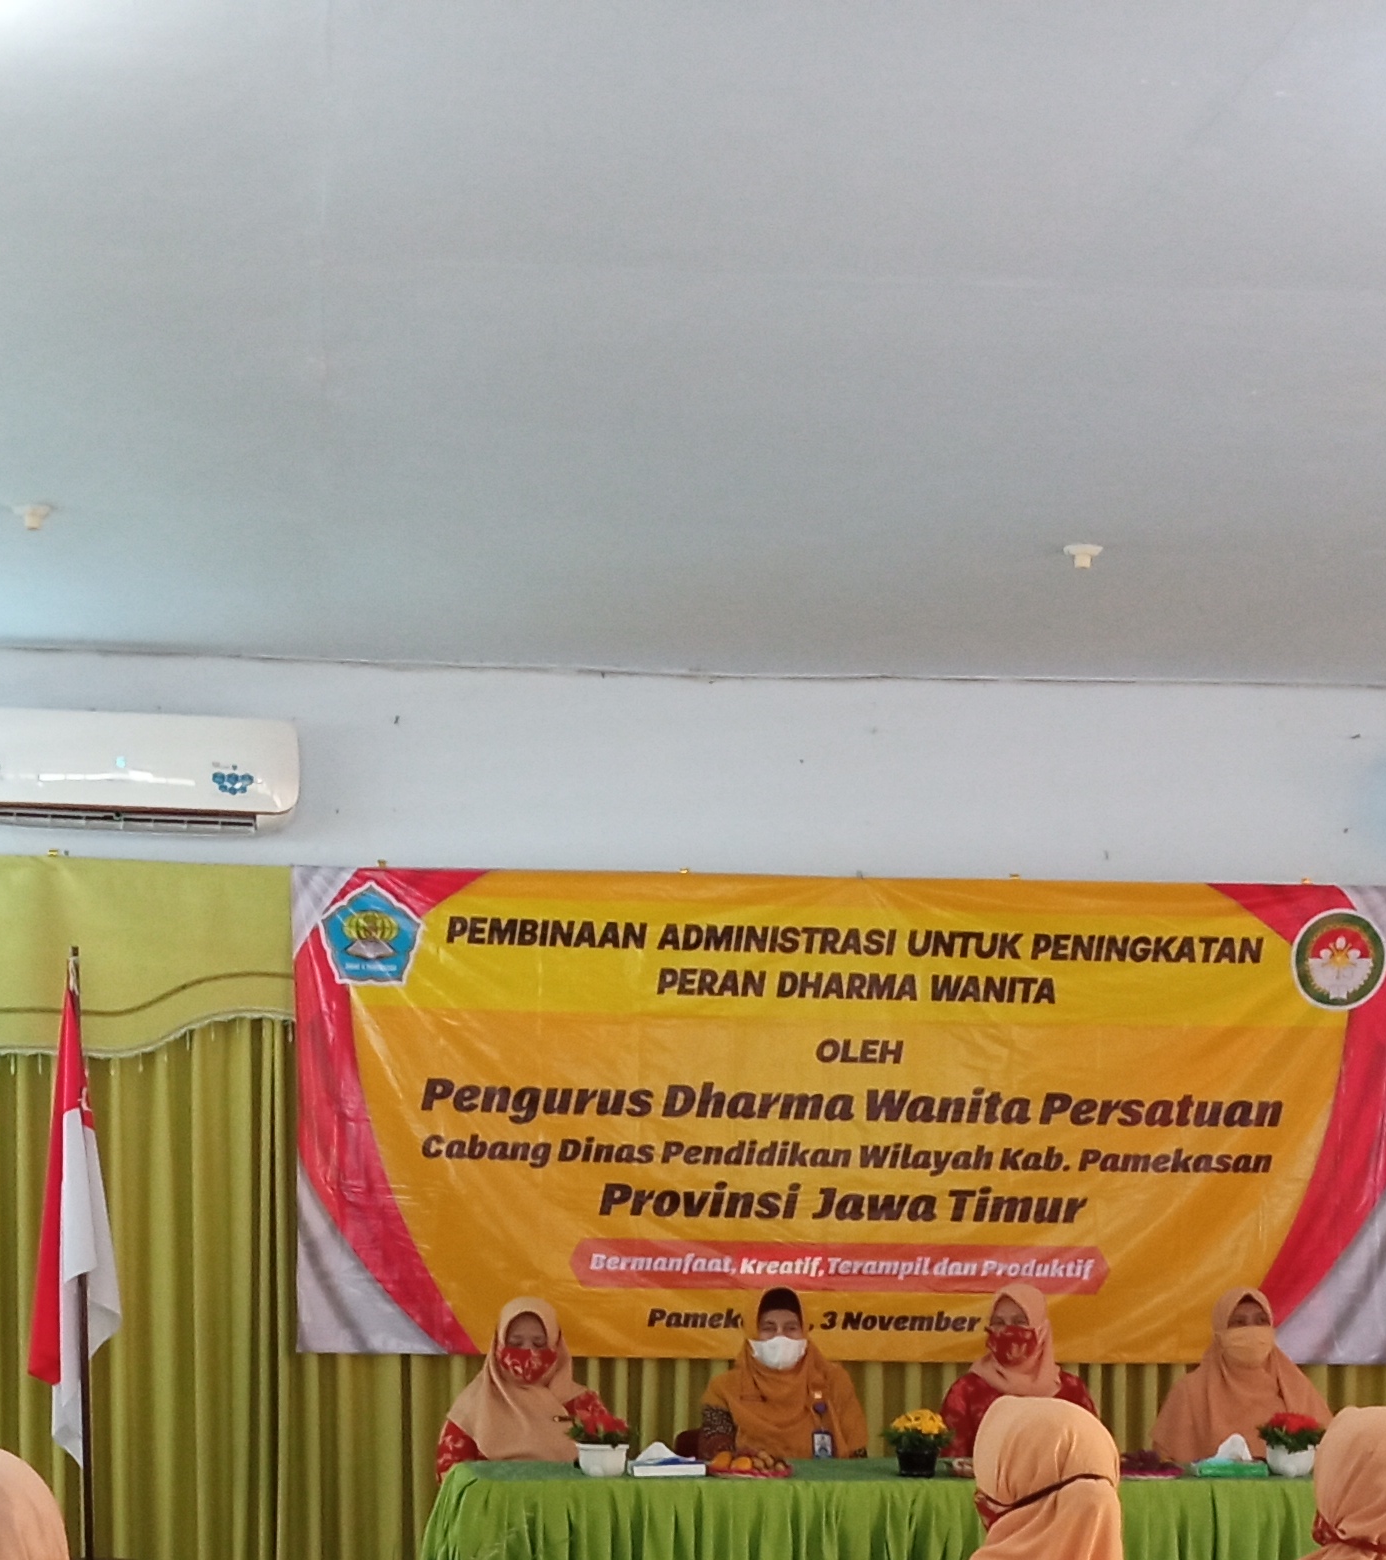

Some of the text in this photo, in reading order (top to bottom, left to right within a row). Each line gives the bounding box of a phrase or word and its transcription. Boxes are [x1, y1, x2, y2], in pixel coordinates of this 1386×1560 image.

[447, 917, 1263, 963] PEMBINAAN ADMINISTRASI UNTUK PENINGKATAN
[657, 968, 1055, 1004] PERAN DHARMA WANITA
[816, 1039, 903, 1064] OLEH
[422, 1079, 1282, 1127] Pengurus Dharma Wanita Persatuan
[422, 1135, 1272, 1176] Cabang Dinas Pendidikan Wilayah Kab. Pamekasan
[599, 1182, 1087, 1224] Provinsi Jawa Timur
[590, 1253, 1095, 1280] Bermanfaat, Kreatif, Terampil dan Produktif
[820, 1311, 837, 1330] 3
[842, 1311, 981, 1331] November
